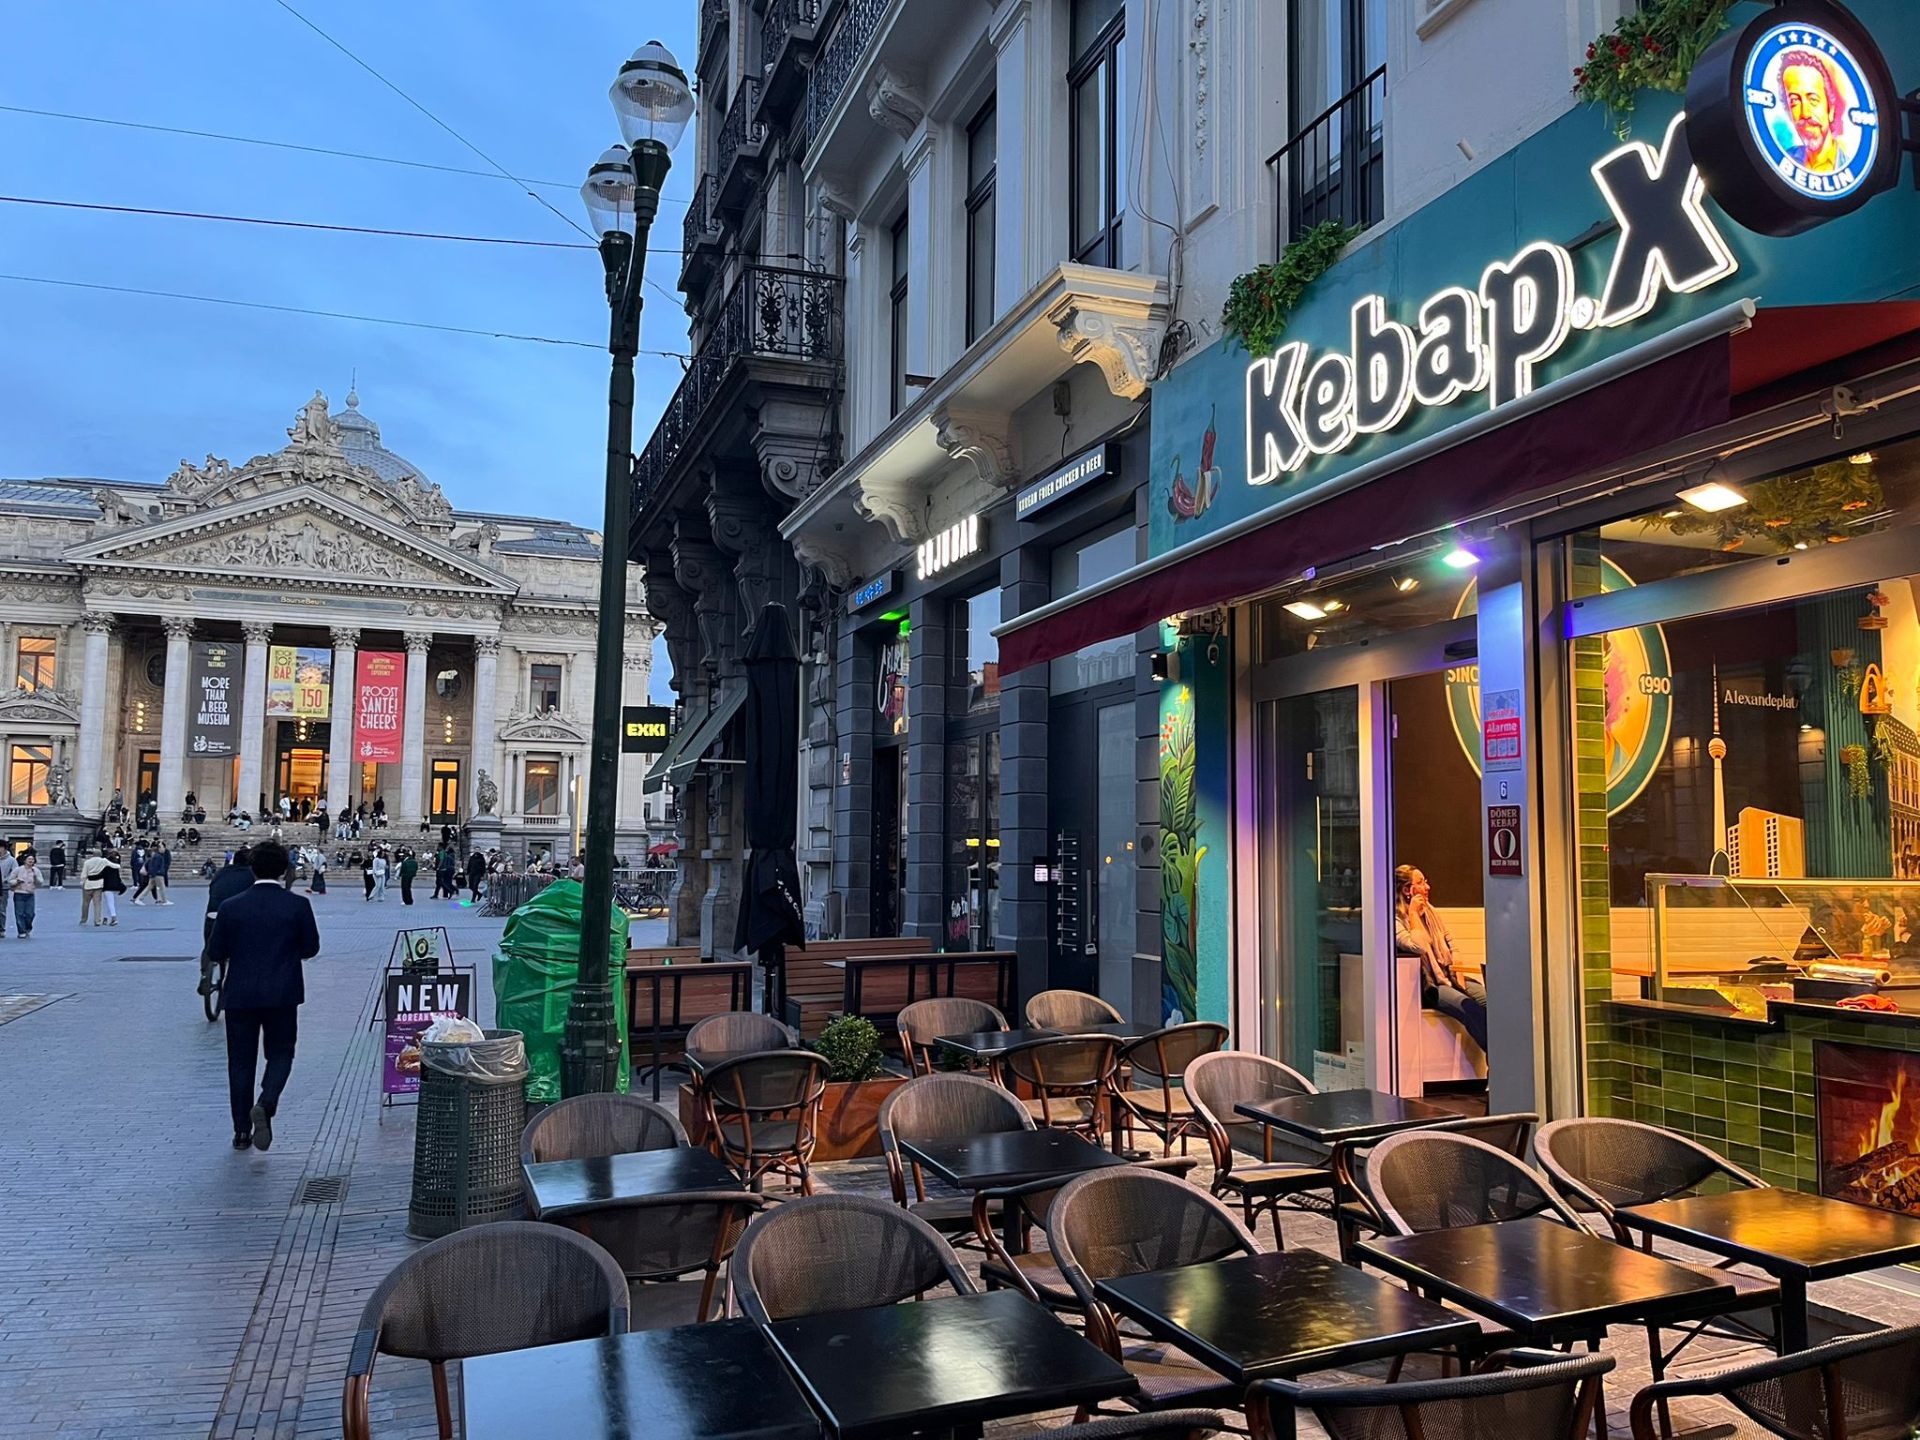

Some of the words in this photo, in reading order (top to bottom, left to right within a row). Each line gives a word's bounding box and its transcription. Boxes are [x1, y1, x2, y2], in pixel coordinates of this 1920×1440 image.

[1778, 157, 1854, 191] BERLIN
[273, 666, 292, 680] BAR
[1447, 665, 1479, 682] SINC
[202, 676, 230, 689] MORE
[1640, 675, 1671, 694] 1990
[205, 689, 225, 700] THAN
[301, 688, 322, 707] 150
[361, 686, 398, 697] PROOST
[201, 701, 206, 712] A
[209, 701, 227, 713] BEER
[198, 712, 230, 725] MUSEUM
[360, 713, 397, 730] CHEERS
[627, 723, 666, 737] EXKI
[1487, 722, 1518, 734] Alarme
[1500, 782, 1507, 797] 6
[1490, 808, 1517, 818] DÖNER
[1490, 819, 1517, 828] KEBAP
[397, 984, 459, 1012] NEW
[397, 1013, 429, 1022] KOREAN
